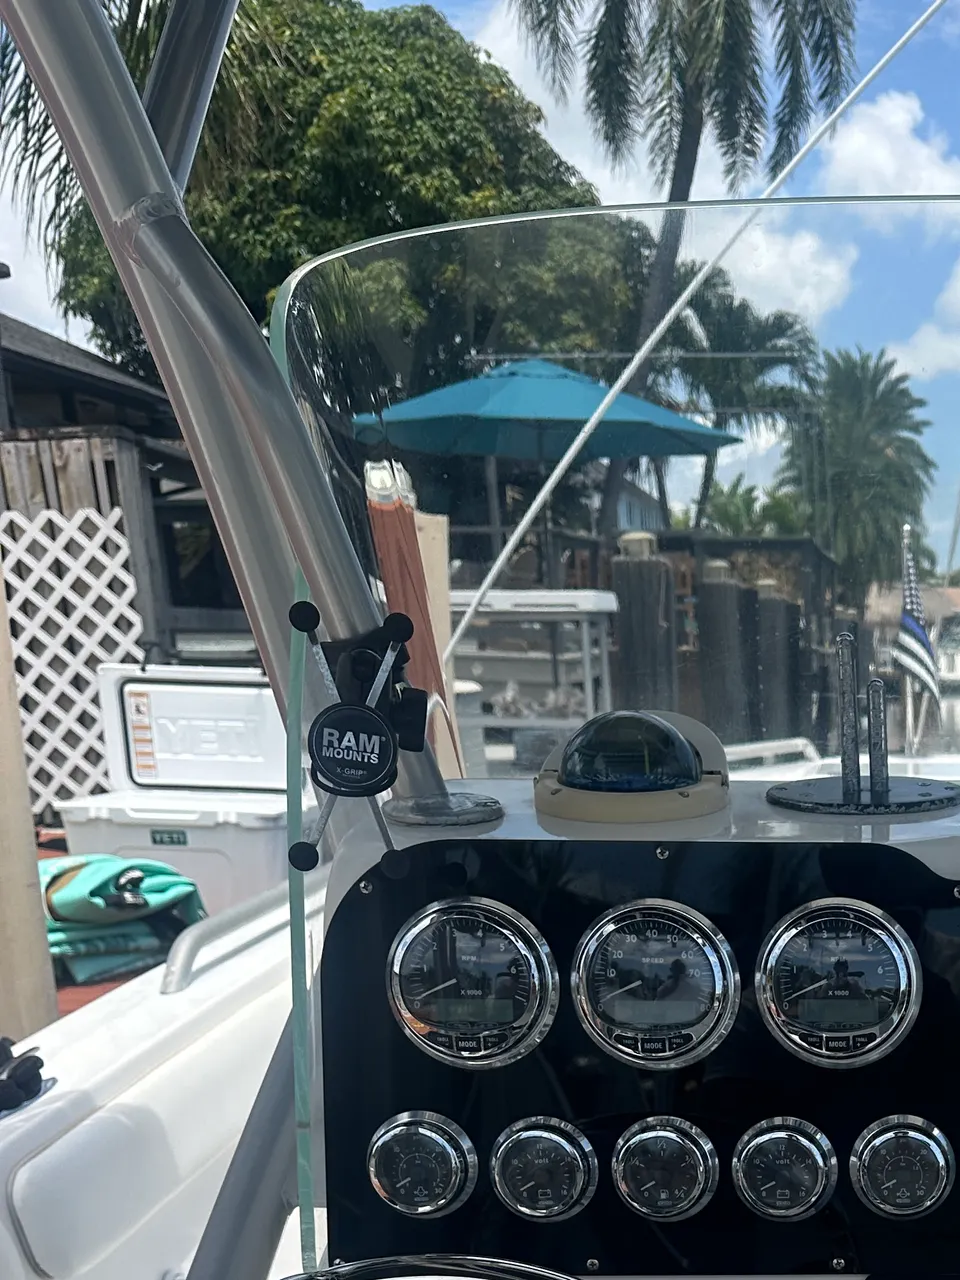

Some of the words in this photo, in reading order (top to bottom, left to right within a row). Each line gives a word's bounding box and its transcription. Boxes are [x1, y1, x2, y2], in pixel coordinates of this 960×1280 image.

[323, 727, 381, 754] RAM
[322, 746, 379, 764] MOUNTS
[153, 834, 185, 844] YETI
[646, 929, 658, 938] 40
[625, 935, 637, 943] 30
[666, 935, 678, 943] 50
[612, 951, 623, 959] 20
[681, 951, 694, 959] 60
[607, 969, 616, 977] 10
[688, 969, 700, 977] 70
[458, 1040, 478, 1048] MODE
